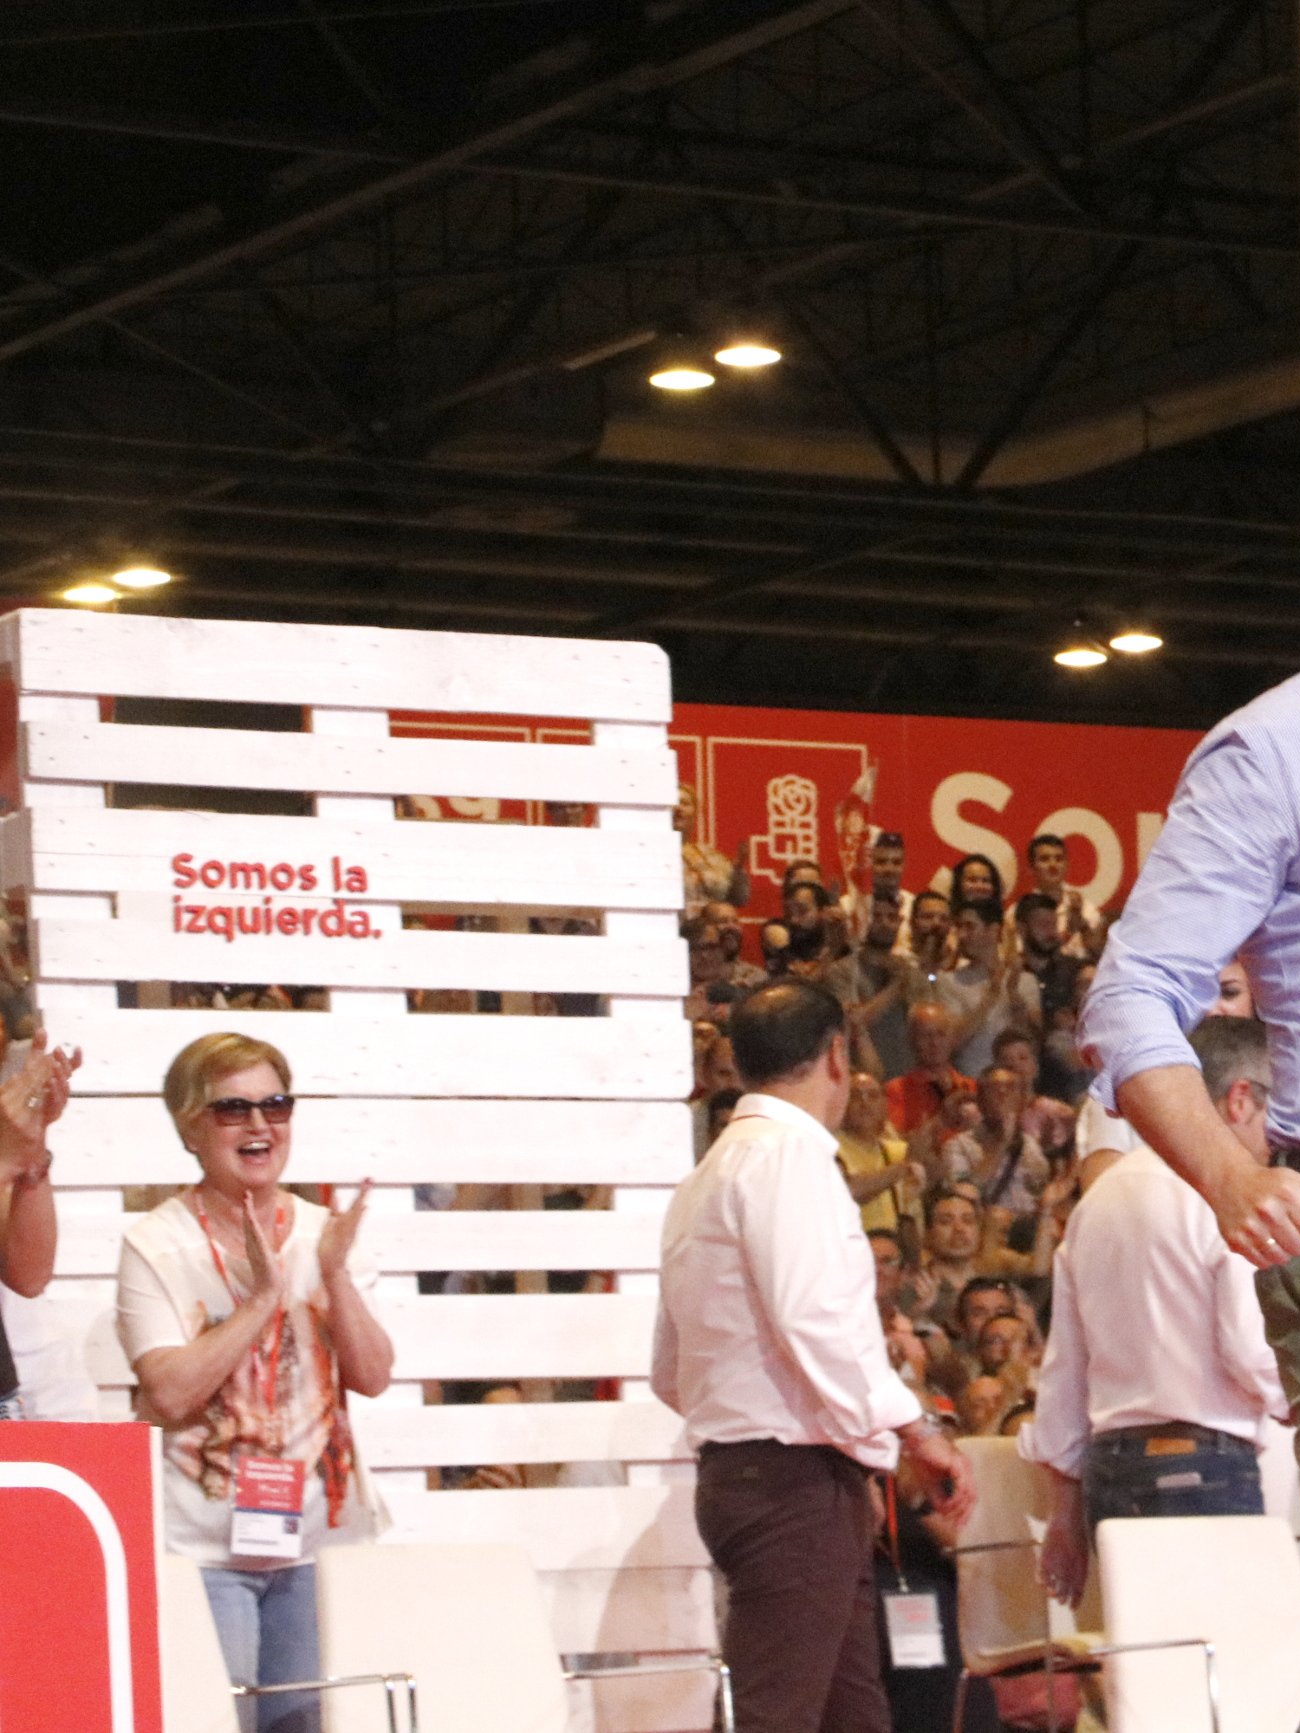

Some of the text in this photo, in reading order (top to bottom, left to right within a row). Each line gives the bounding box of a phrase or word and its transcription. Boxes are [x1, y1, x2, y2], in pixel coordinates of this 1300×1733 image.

[171, 853, 368, 893] Somos la
[172, 895, 382, 943] izquierda.
